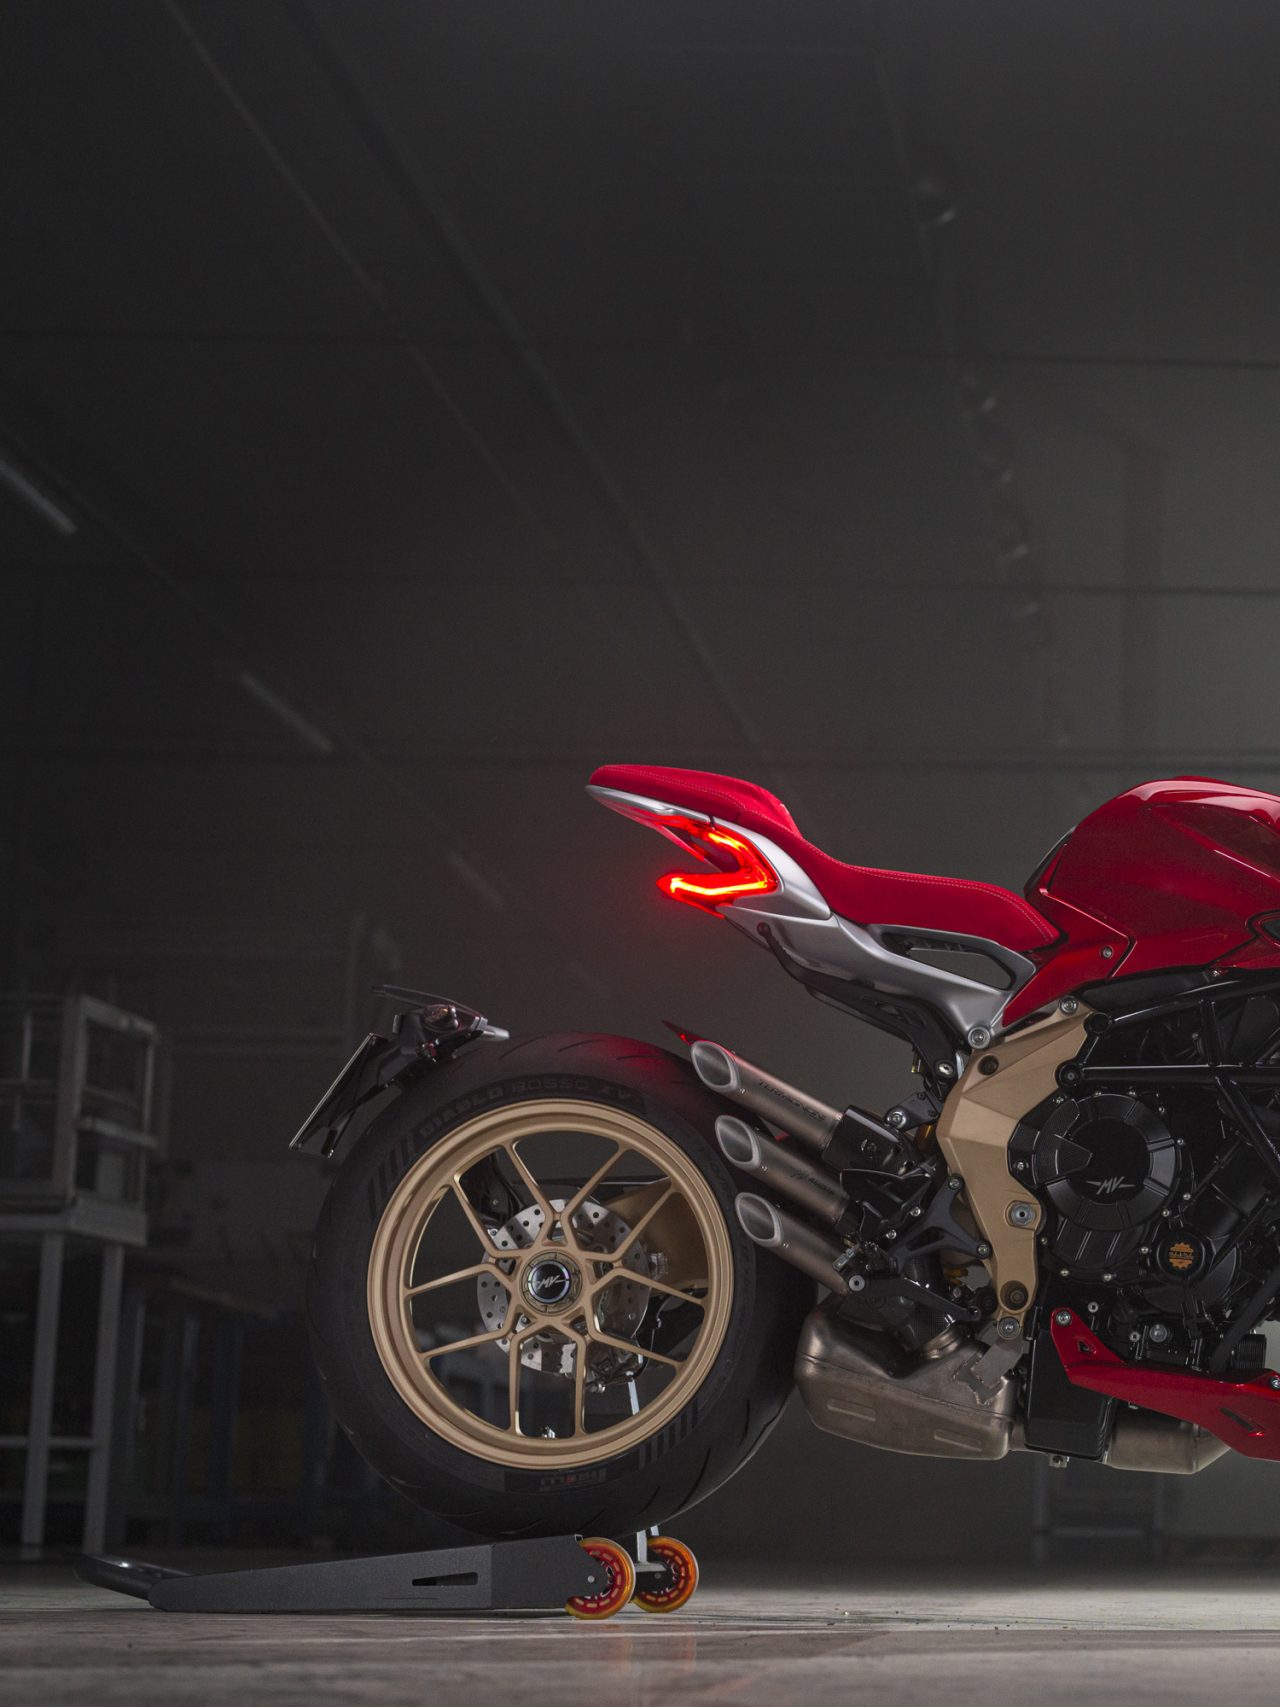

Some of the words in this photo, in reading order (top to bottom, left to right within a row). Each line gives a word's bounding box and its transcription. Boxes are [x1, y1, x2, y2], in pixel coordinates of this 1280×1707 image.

[419, 1086, 504, 1138] DIABLO
[511, 1077, 590, 1092] ROSSO
[1094, 1175, 1128, 1196] MV
[536, 1274, 562, 1290] MV
